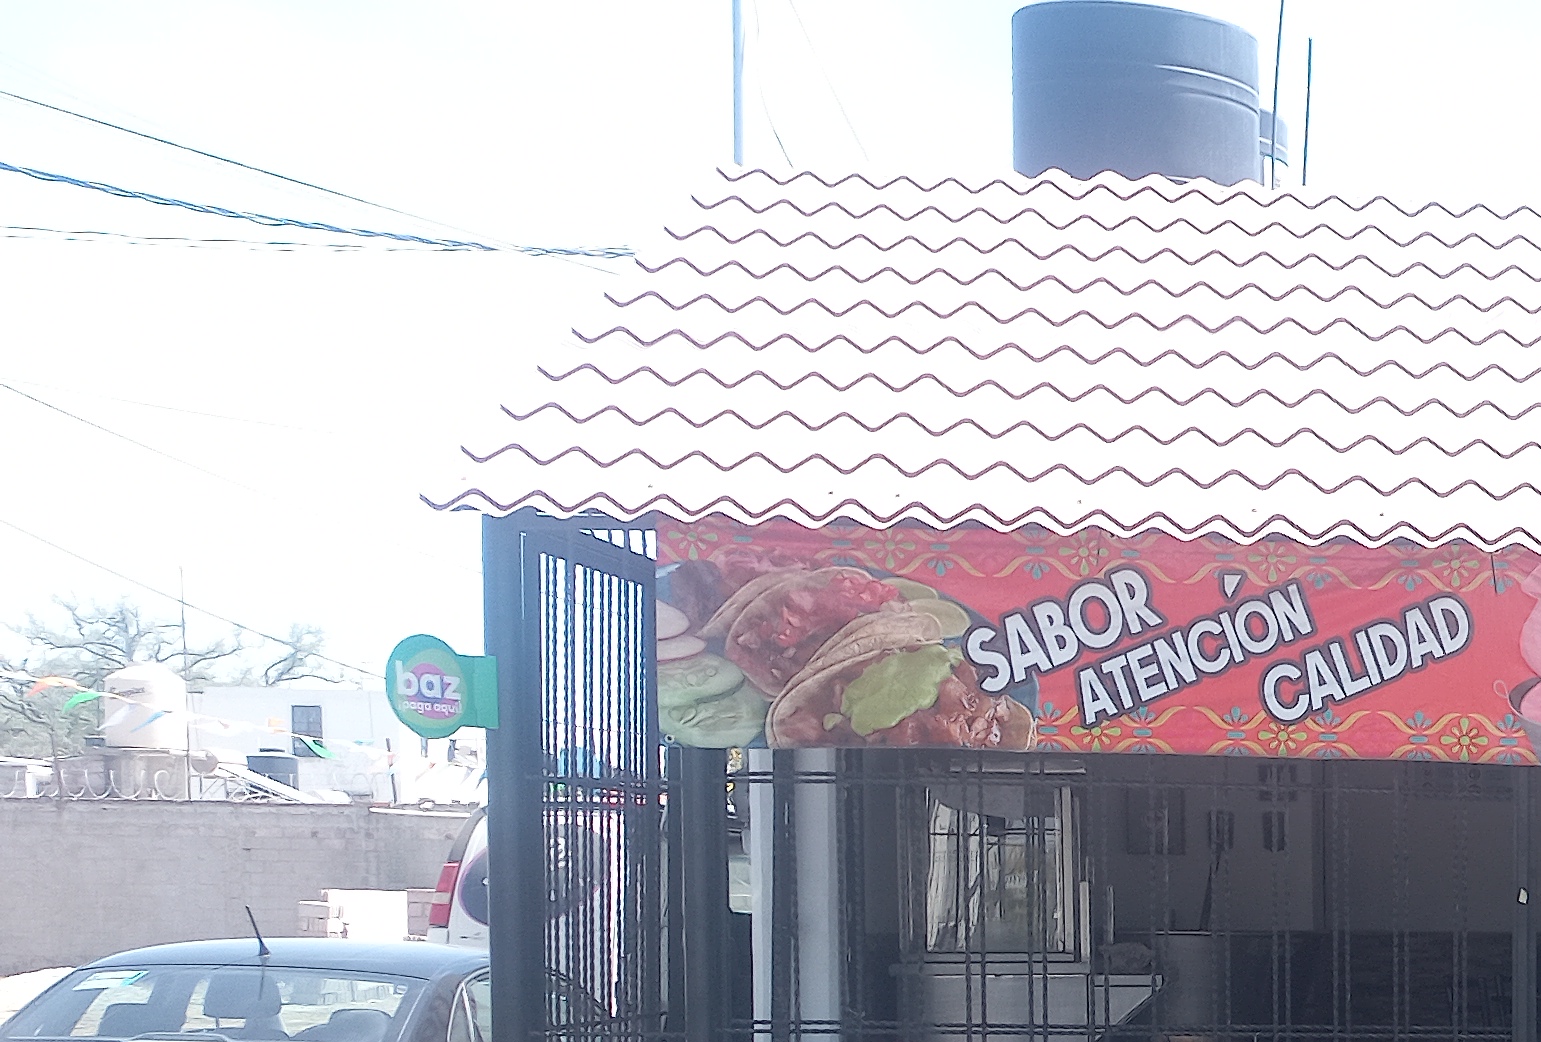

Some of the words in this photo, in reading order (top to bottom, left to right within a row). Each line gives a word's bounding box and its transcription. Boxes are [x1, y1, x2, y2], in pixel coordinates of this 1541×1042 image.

[394, 660, 462, 701] baz
[965, 567, 1166, 693] SABOR
[1074, 575, 1314, 727] ATENCIÓN
[1259, 594, 1473, 725] CALIDAD
